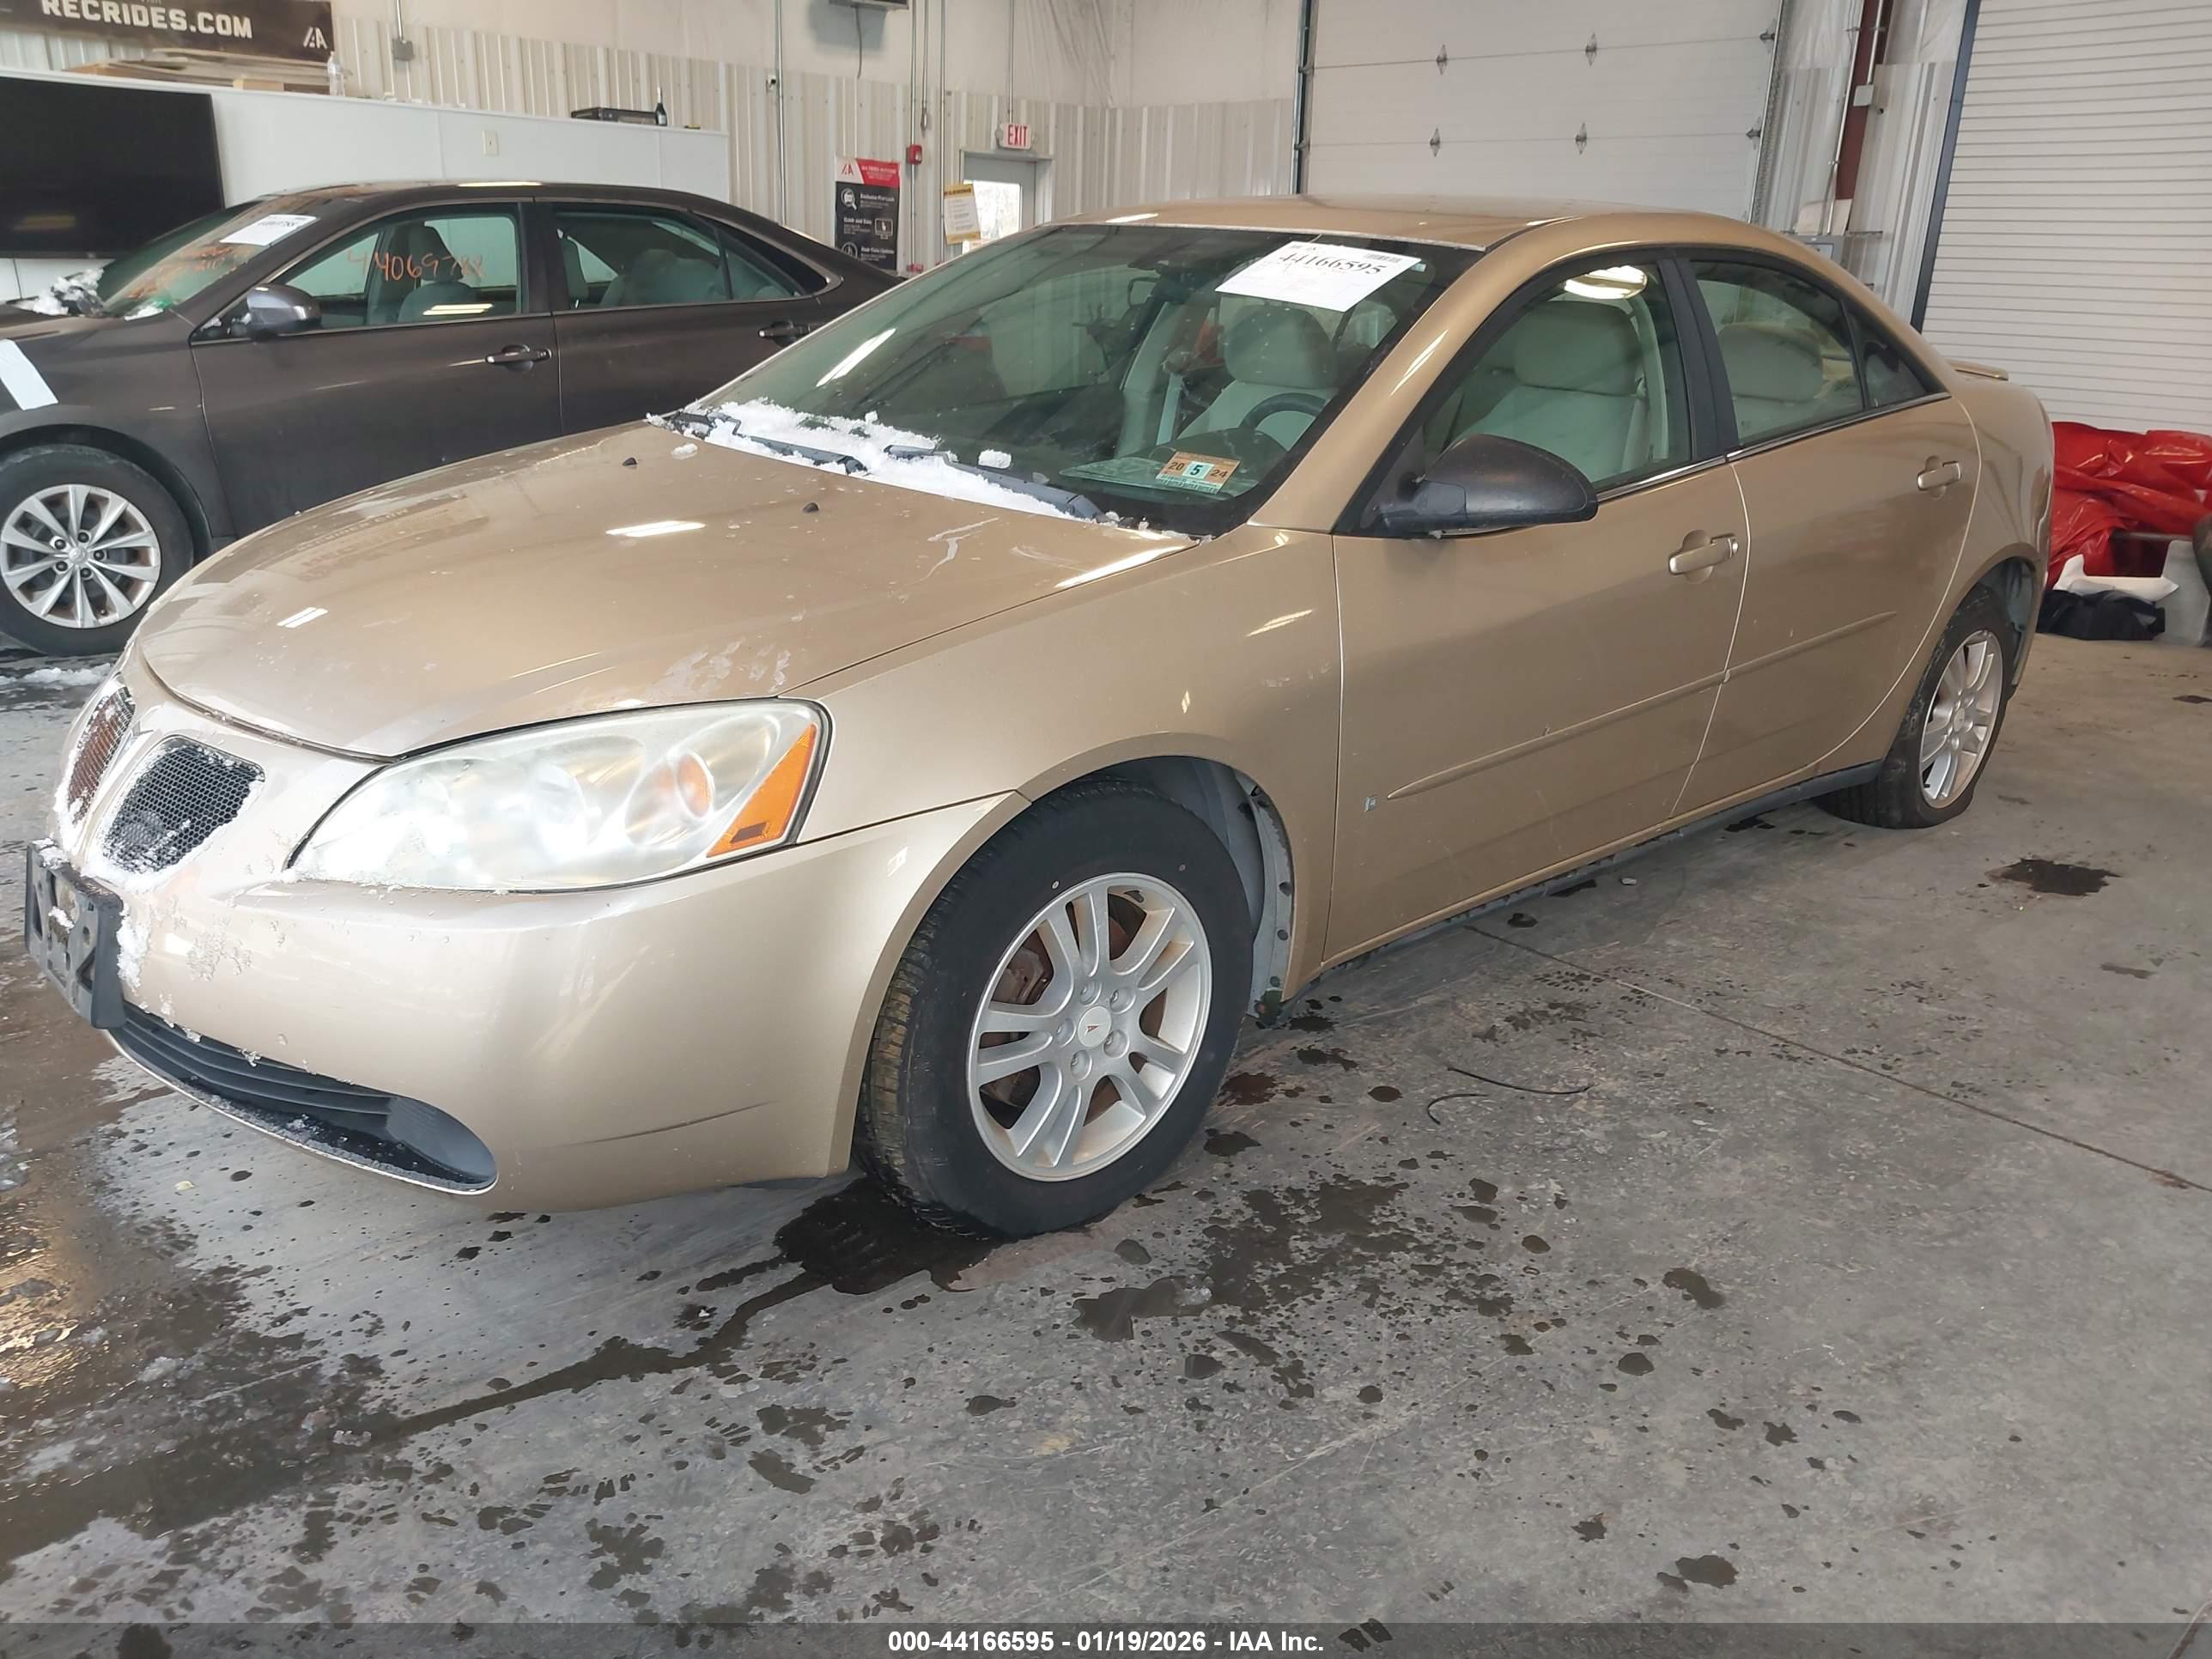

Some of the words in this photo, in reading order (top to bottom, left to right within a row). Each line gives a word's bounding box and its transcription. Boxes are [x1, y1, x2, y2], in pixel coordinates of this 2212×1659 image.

[43, 0, 252, 40] RECRIDES.COM
[1007, 125, 1028, 147] EXIT
[1279, 253, 1387, 274] 44166595
[1169, 462, 1185, 471] 20
[1190, 464, 1204, 477] 5
[1211, 469, 1228, 477] 24
